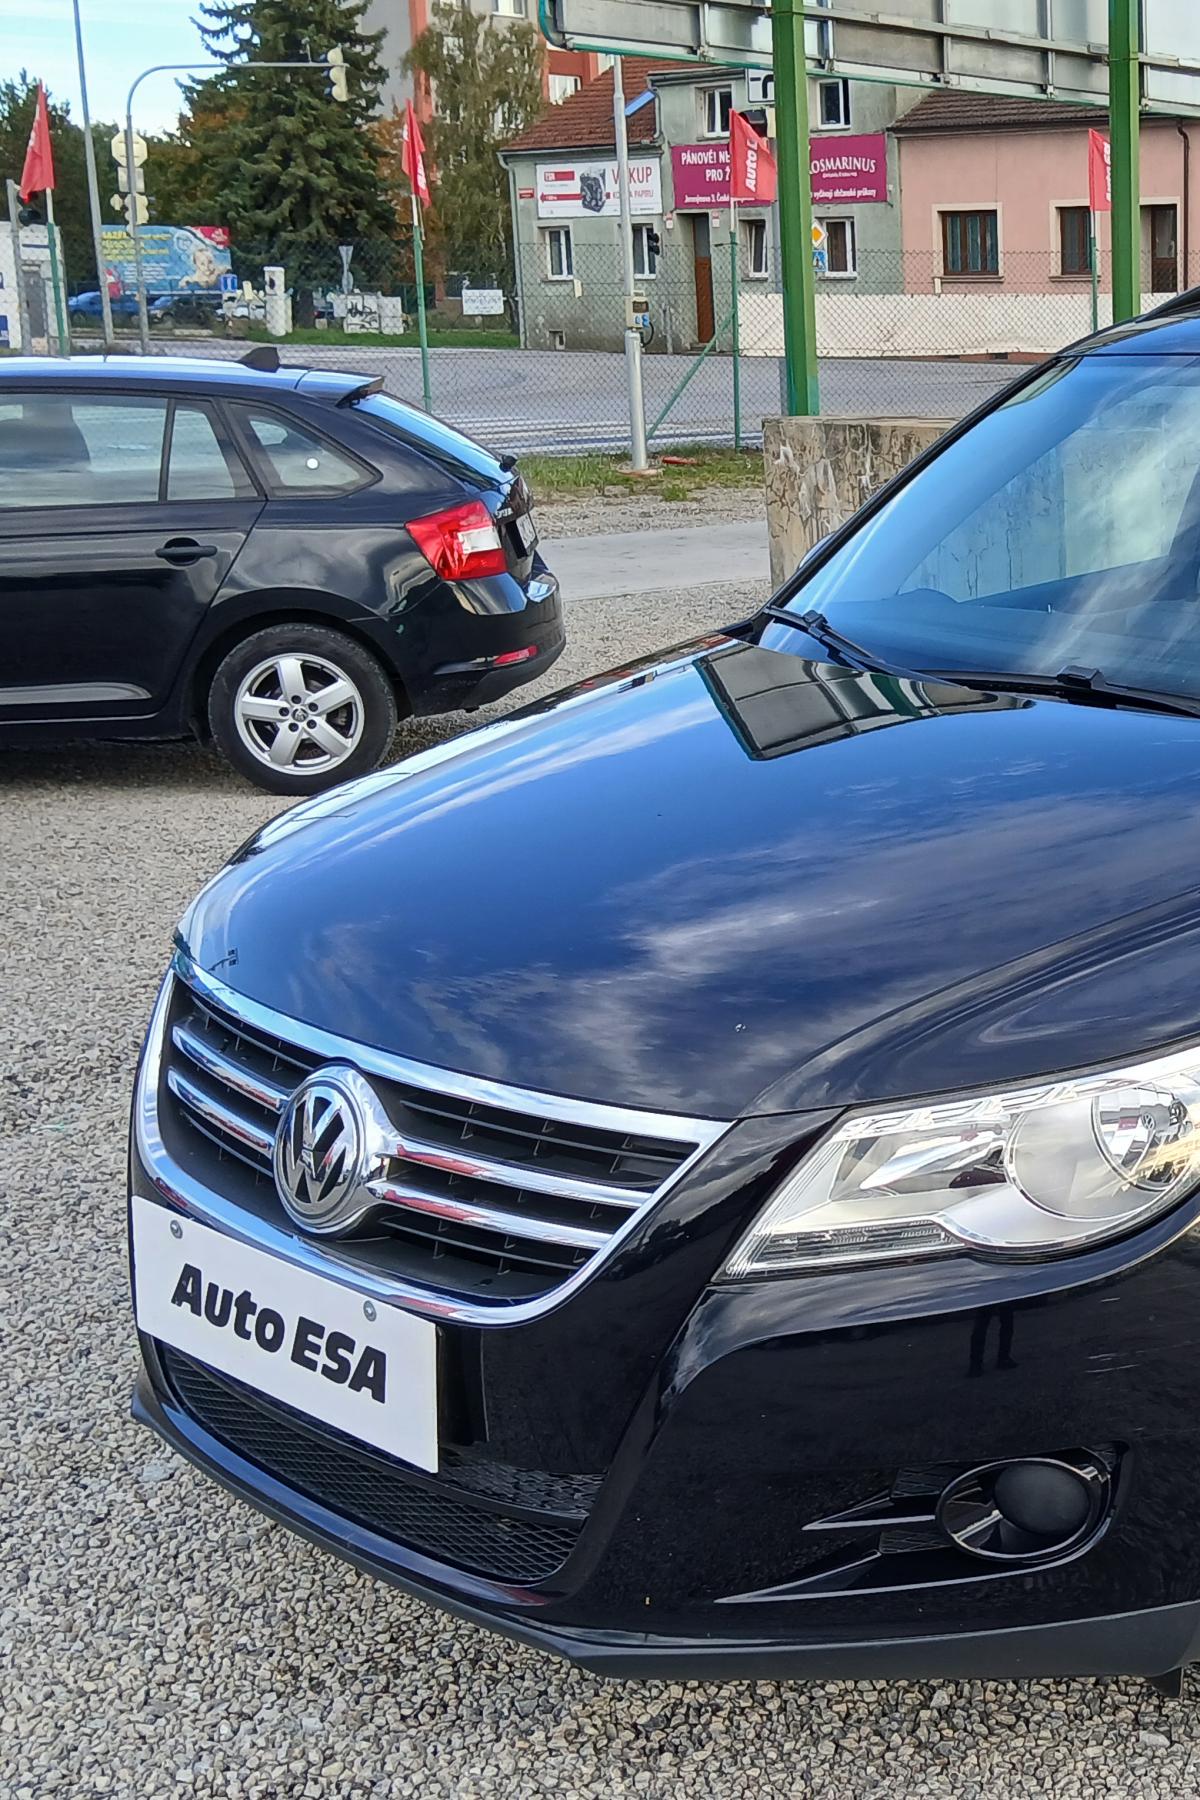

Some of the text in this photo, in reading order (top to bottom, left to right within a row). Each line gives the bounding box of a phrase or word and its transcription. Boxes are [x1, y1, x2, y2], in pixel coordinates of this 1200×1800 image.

[681, 149, 717, 165] PÁNOVÉ!
[809, 157, 876, 174] OSMARINUS
[612, 166, 652, 184] VKUP
[705, 168, 723, 182] PRO
[171, 1263, 387, 1404] Auto ESA
